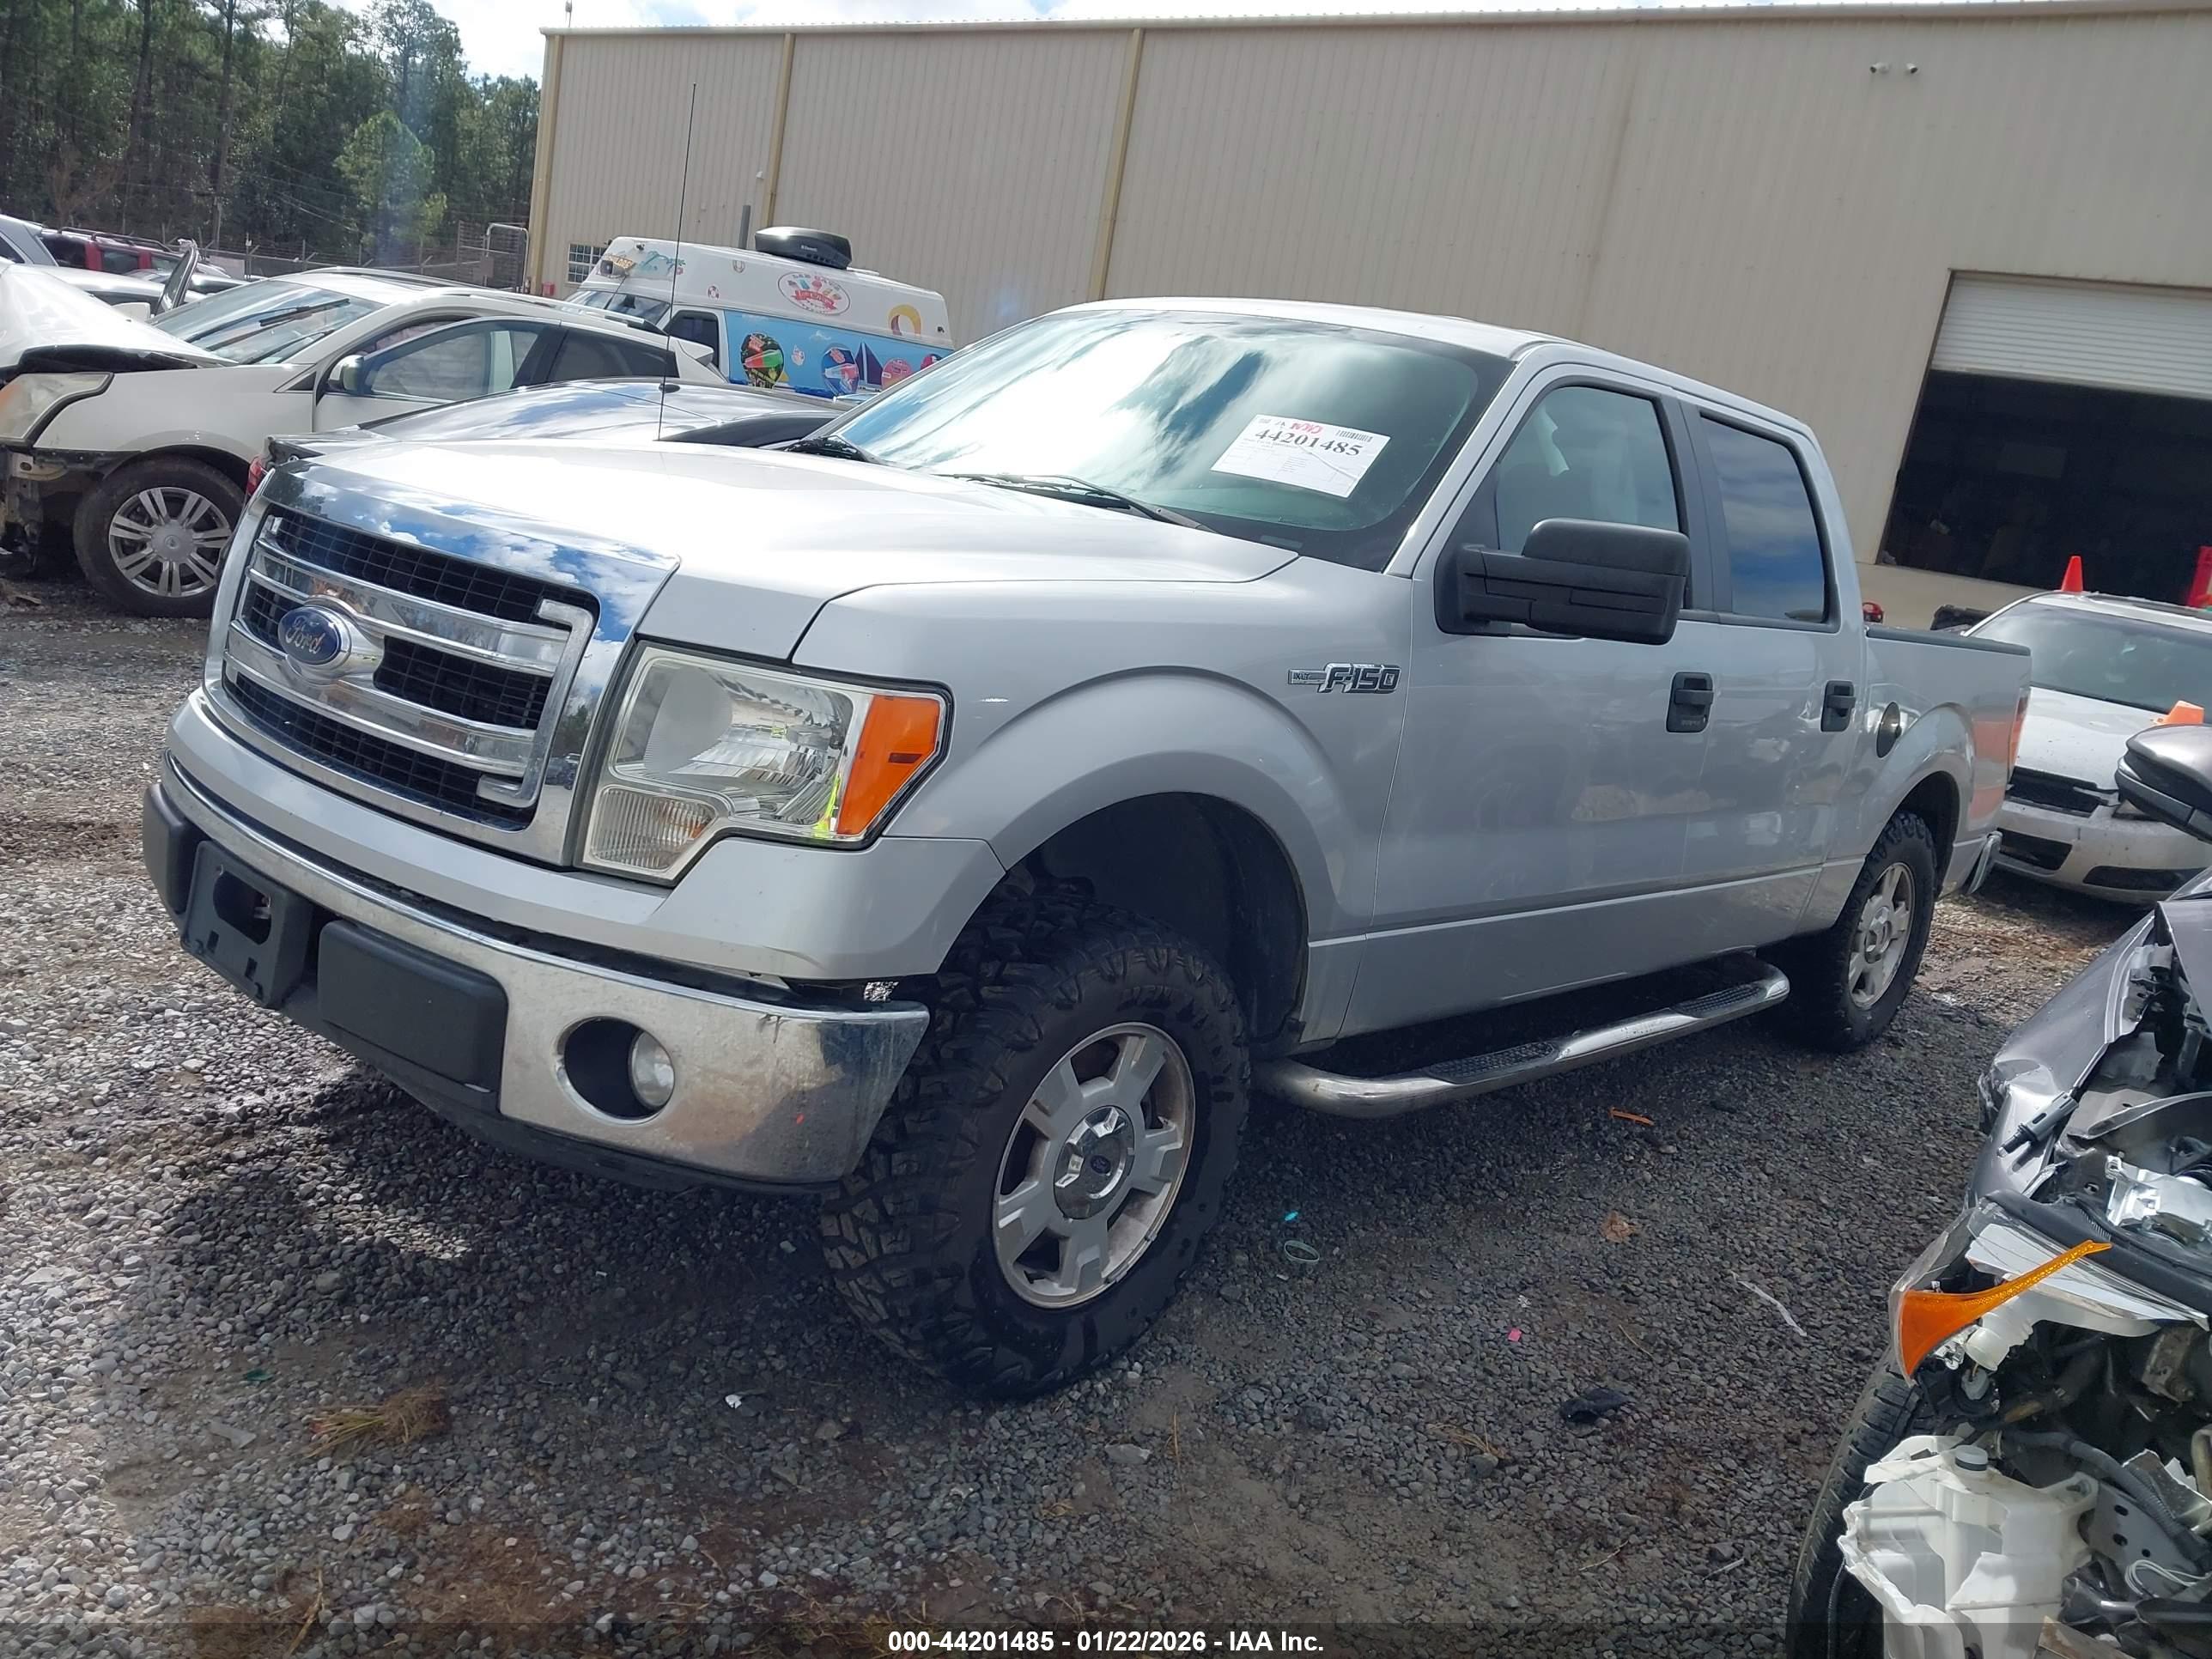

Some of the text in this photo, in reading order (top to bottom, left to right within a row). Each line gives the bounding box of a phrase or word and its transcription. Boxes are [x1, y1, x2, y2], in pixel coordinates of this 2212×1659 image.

[1255, 428, 1364, 456] 44201485
[285, 615, 326, 654] Ford
[1318, 663, 1401, 693] F-150
